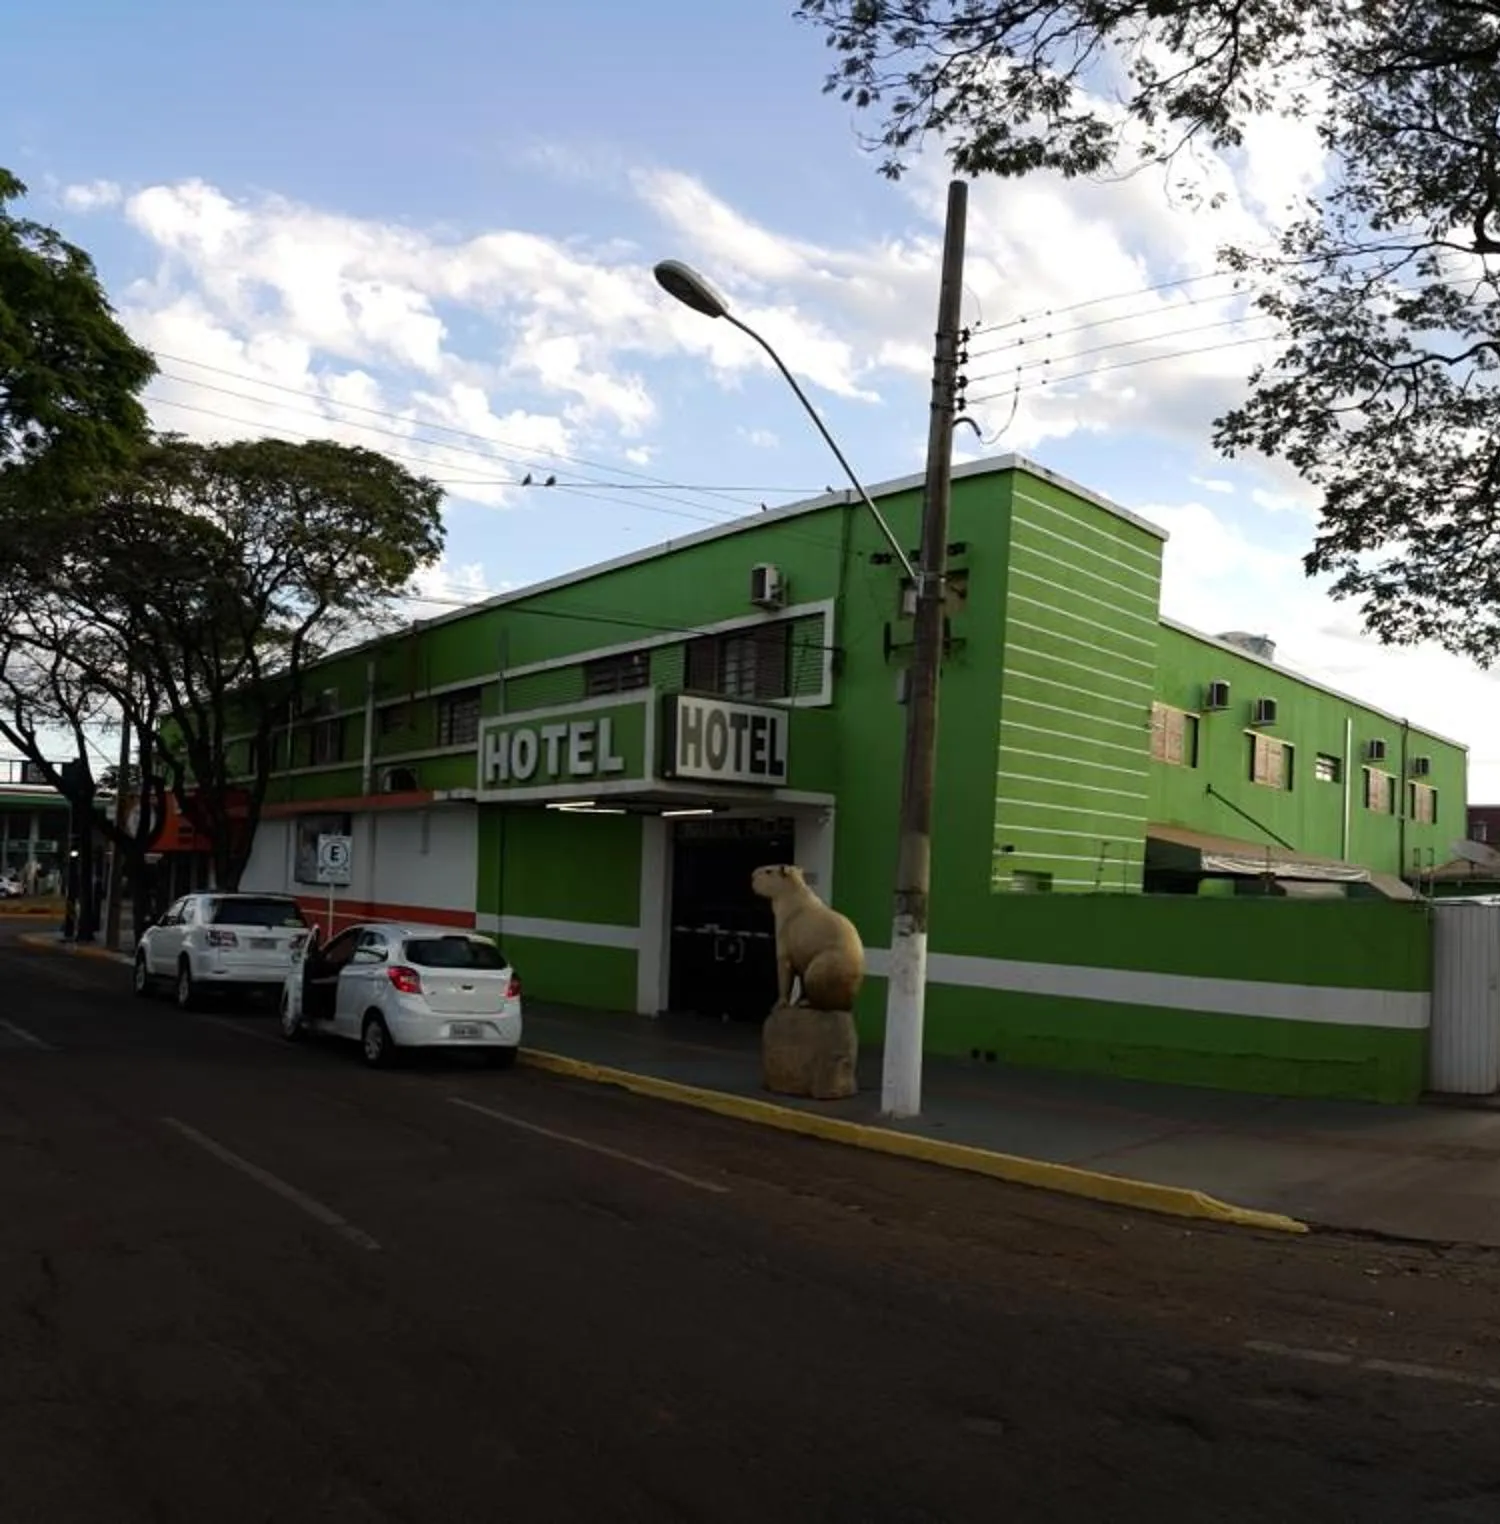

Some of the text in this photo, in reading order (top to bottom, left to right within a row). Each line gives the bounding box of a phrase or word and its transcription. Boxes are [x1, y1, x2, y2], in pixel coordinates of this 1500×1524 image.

[485, 717, 624, 783] HOTEL
[680, 705, 784, 777] HOTEL
[330, 845, 341, 861] E
